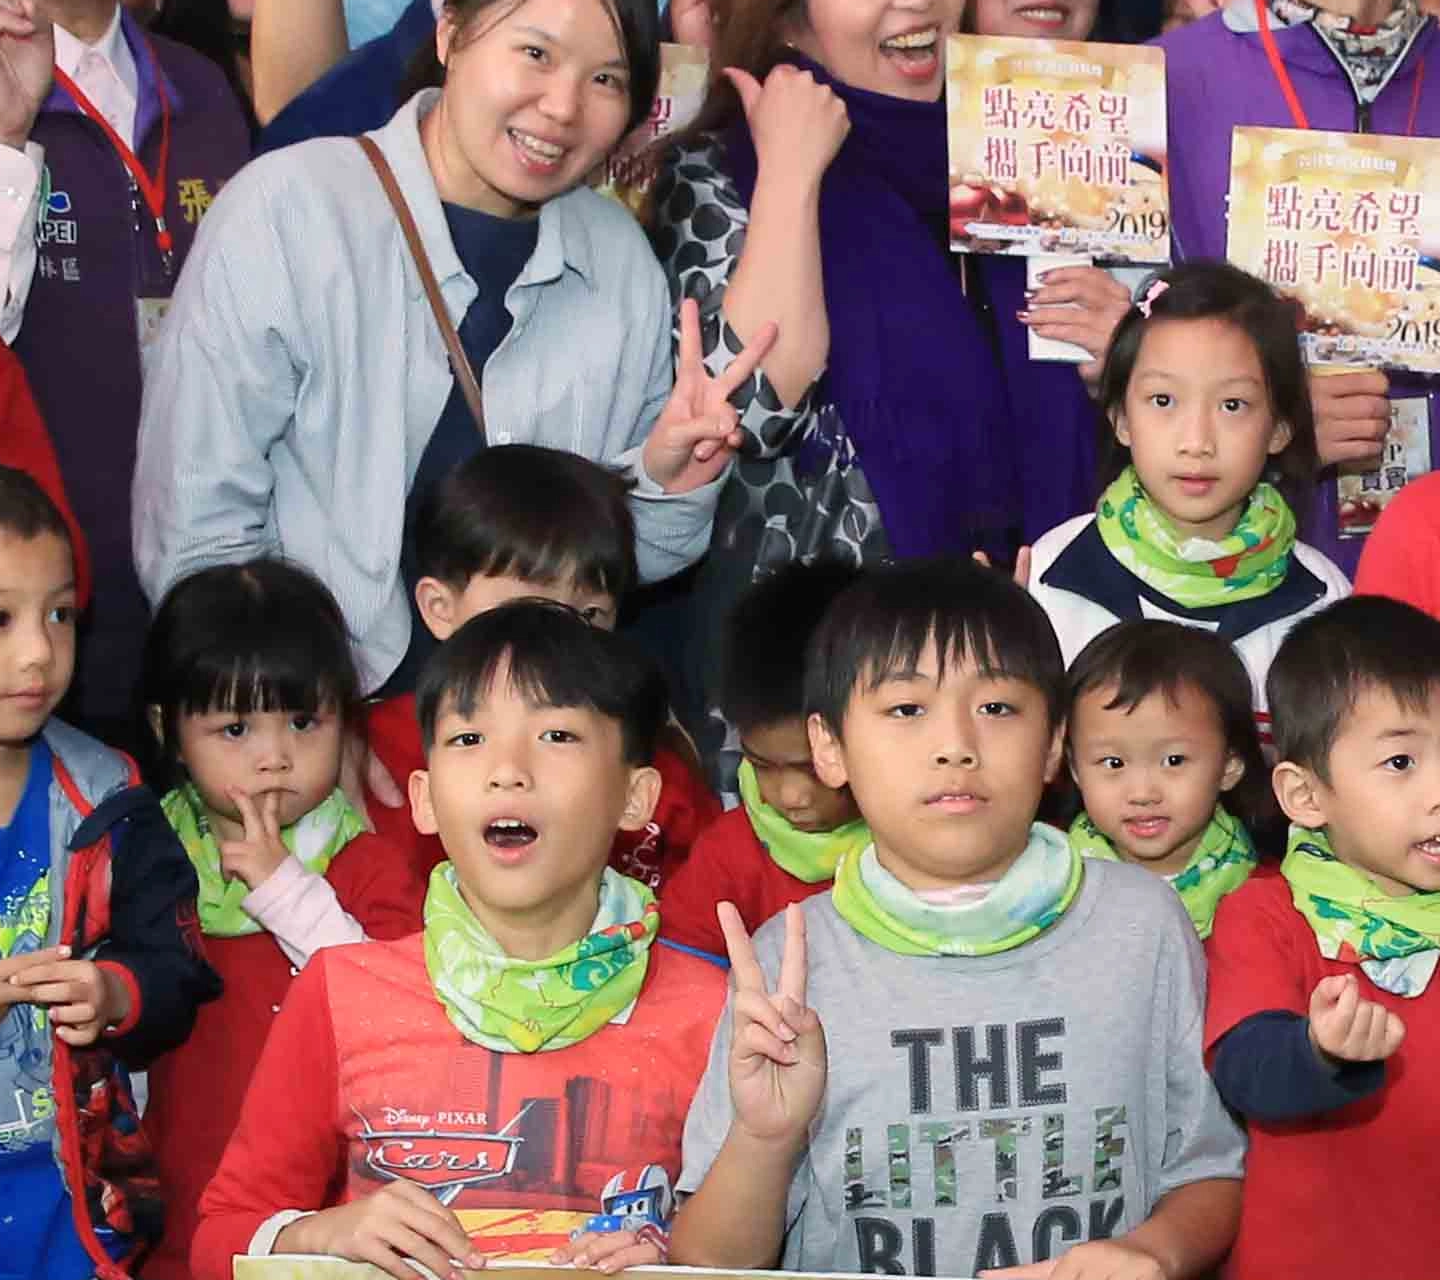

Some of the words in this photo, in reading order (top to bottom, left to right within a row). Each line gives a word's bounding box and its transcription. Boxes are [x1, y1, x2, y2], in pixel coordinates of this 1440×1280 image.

[984, 88, 1128, 135] 點亮希望
[984, 136, 1129, 185] 攜手向前
[1106, 207, 1166, 240] 2019
[1266, 186, 1421, 237] 點亮希望
[39, 255, 80, 280] 林區
[1264, 240, 1418, 293] 攜手向前
[890, 1017, 1068, 1114] THE
[383, 1106, 431, 1128] Disney
[437, 1111, 488, 1126] PIXAR
[370, 1140, 496, 1173] Cars
[843, 1104, 1128, 1210] LITTLE
